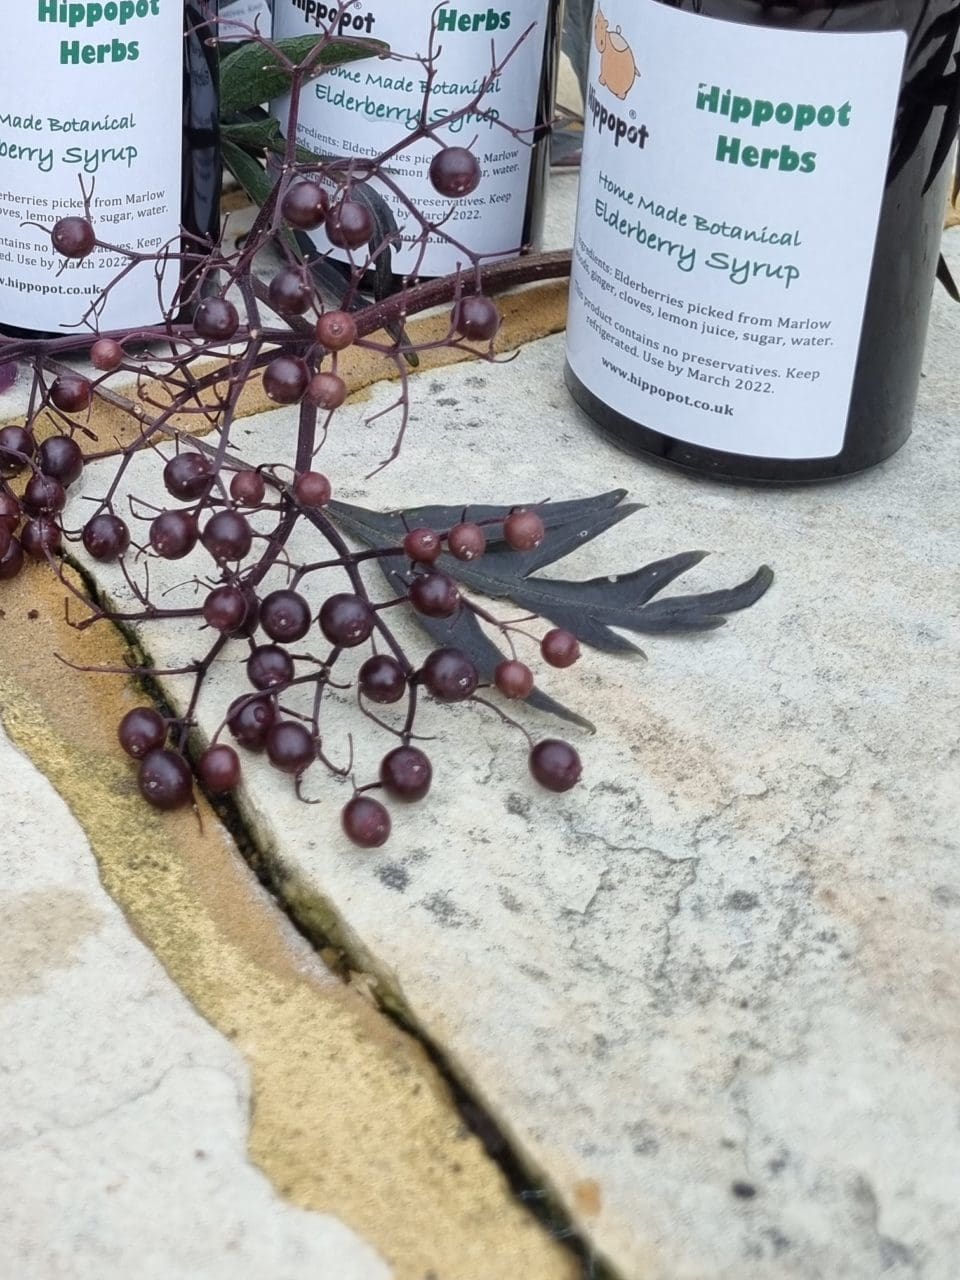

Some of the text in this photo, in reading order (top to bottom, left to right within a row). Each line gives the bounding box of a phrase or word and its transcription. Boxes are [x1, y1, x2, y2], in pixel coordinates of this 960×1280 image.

[438, 8, 510, 32] Herbs
[60, 38, 139, 65] Herbs
[366, 73, 414, 92] Made
[315, 84, 421, 131] Elderberry
[588, 82, 649, 150] Hippopot
[696, 82, 852, 131] Hippopot
[47, 113, 136, 133] Botanical
[62, 145, 138, 173] Syrup
[483, 149, 520, 163] Marlow
[715, 134, 817, 173] Herbs
[492, 163, 520, 176] water.
[95, 197, 122, 208] from
[126, 190, 166, 205] Marlow
[488, 192, 512, 204] Keep
[598, 170, 802, 248] Home Made Botanical
[100, 211, 134, 225] sugar,
[137, 205, 169, 218] water.
[397, 209, 410, 220] by
[452, 209, 482, 220] 2022.
[34, 244, 48, 252] no
[137, 236, 162, 249] Keep
[595, 198, 800, 289] Elderberry Syrup
[17, 253, 37, 266] Use
[40, 257, 55, 271] by
[590, 270, 617, 297] ginger,
[619, 289, 655, 317] cloves,
[657, 307, 698, 330] lemon
[701, 321, 739, 341] juice,
[742, 332, 786, 347] sugar,
[791, 335, 834, 346] water.
[614, 268, 684, 309] Elderberries
[687, 302, 734, 321] picked
[738, 312, 773, 327] from
[777, 317, 832, 330] Marlow
[584, 296, 612, 327] product
[614, 320, 660, 350] contains
[663, 345, 679, 358] no
[681, 351, 781, 379] preservatives.
[786, 368, 820, 382] Keep
[586, 315, 775, 395] refrigerated. Use by March 2022.
[602, 357, 735, 416] www.hippopot.co.uk
